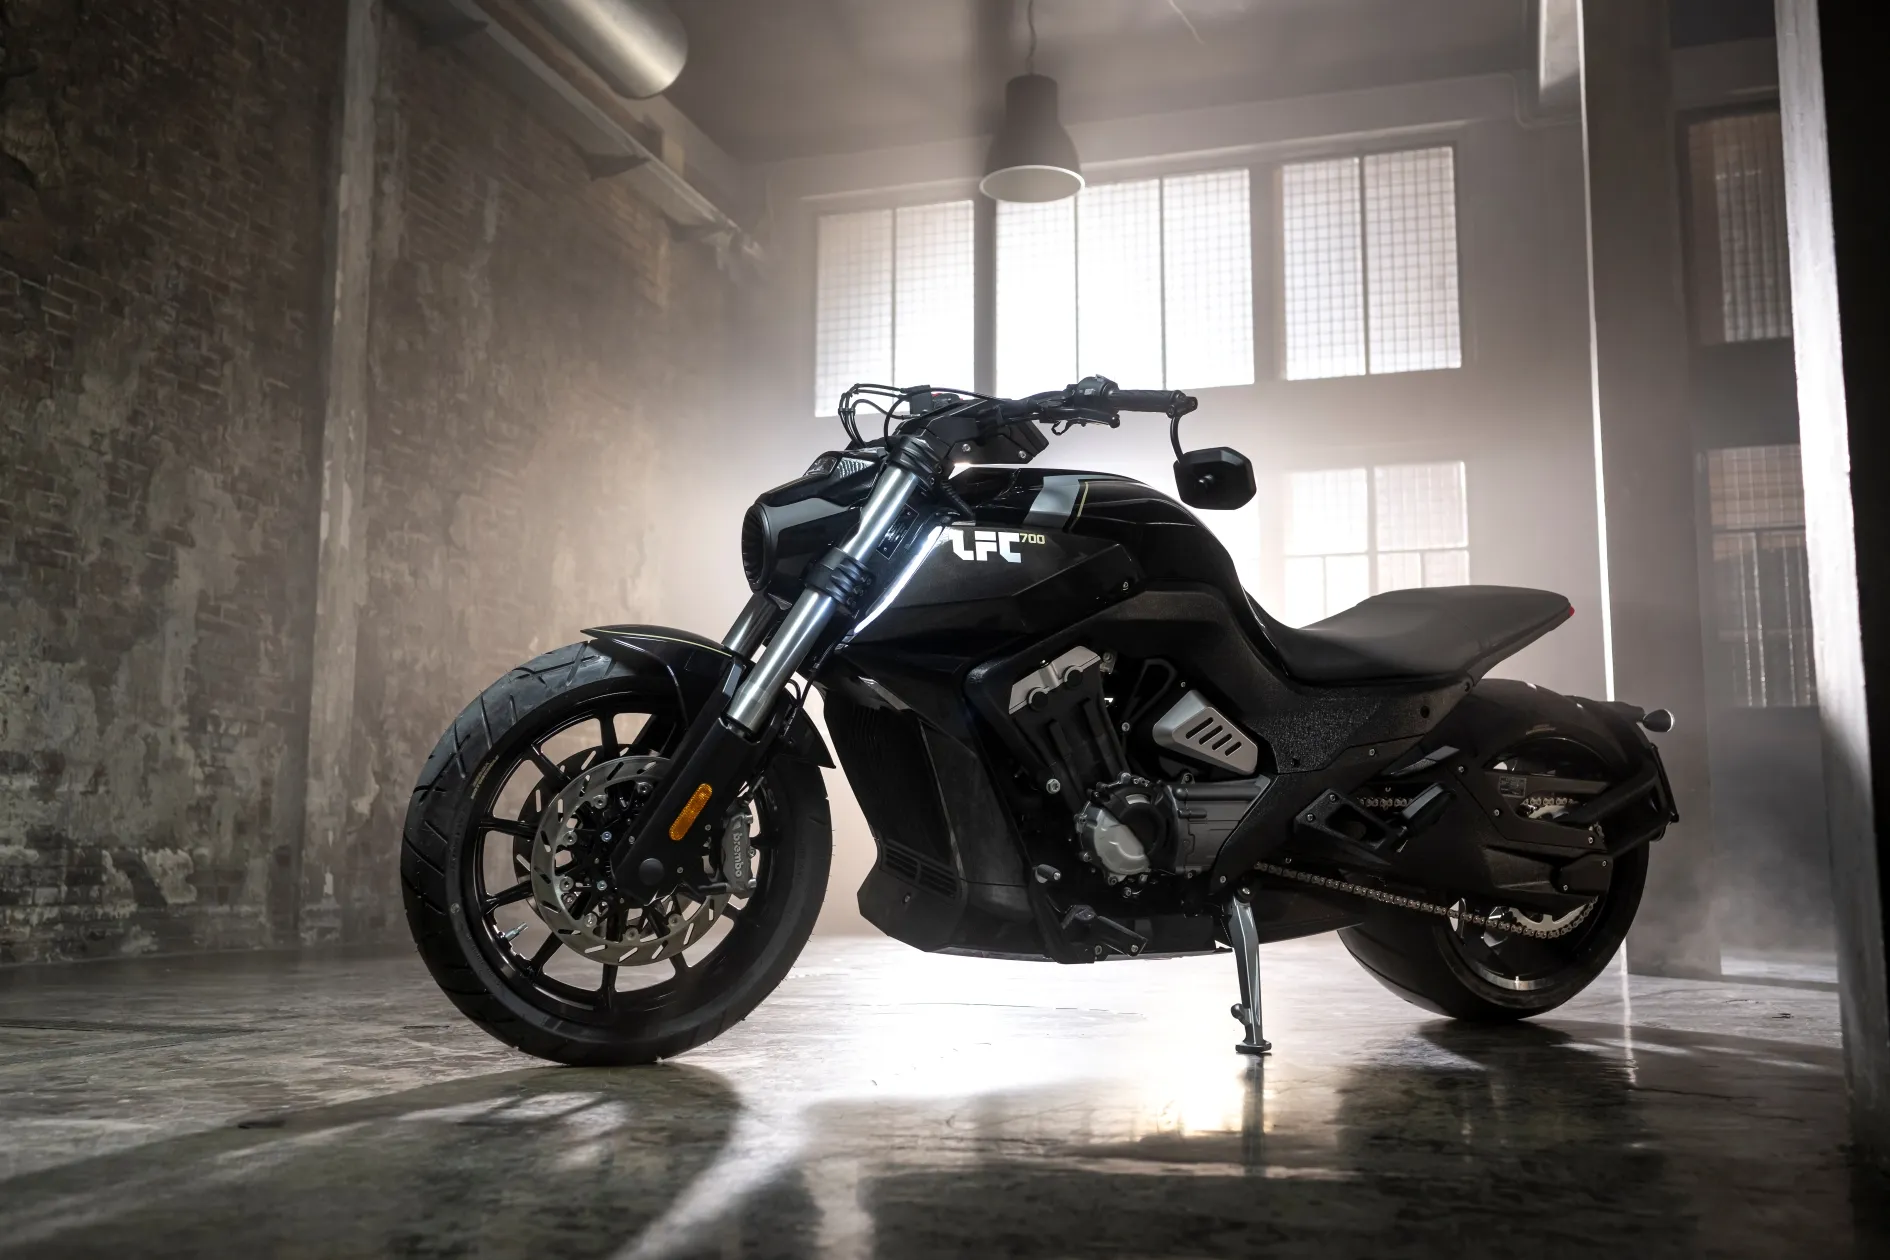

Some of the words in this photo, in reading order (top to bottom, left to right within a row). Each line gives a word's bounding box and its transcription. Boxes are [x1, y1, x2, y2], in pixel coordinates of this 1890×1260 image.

[949, 529, 1022, 563] LFC
[1020, 533, 1046, 545] 700
[733, 832, 744, 878] brembo
